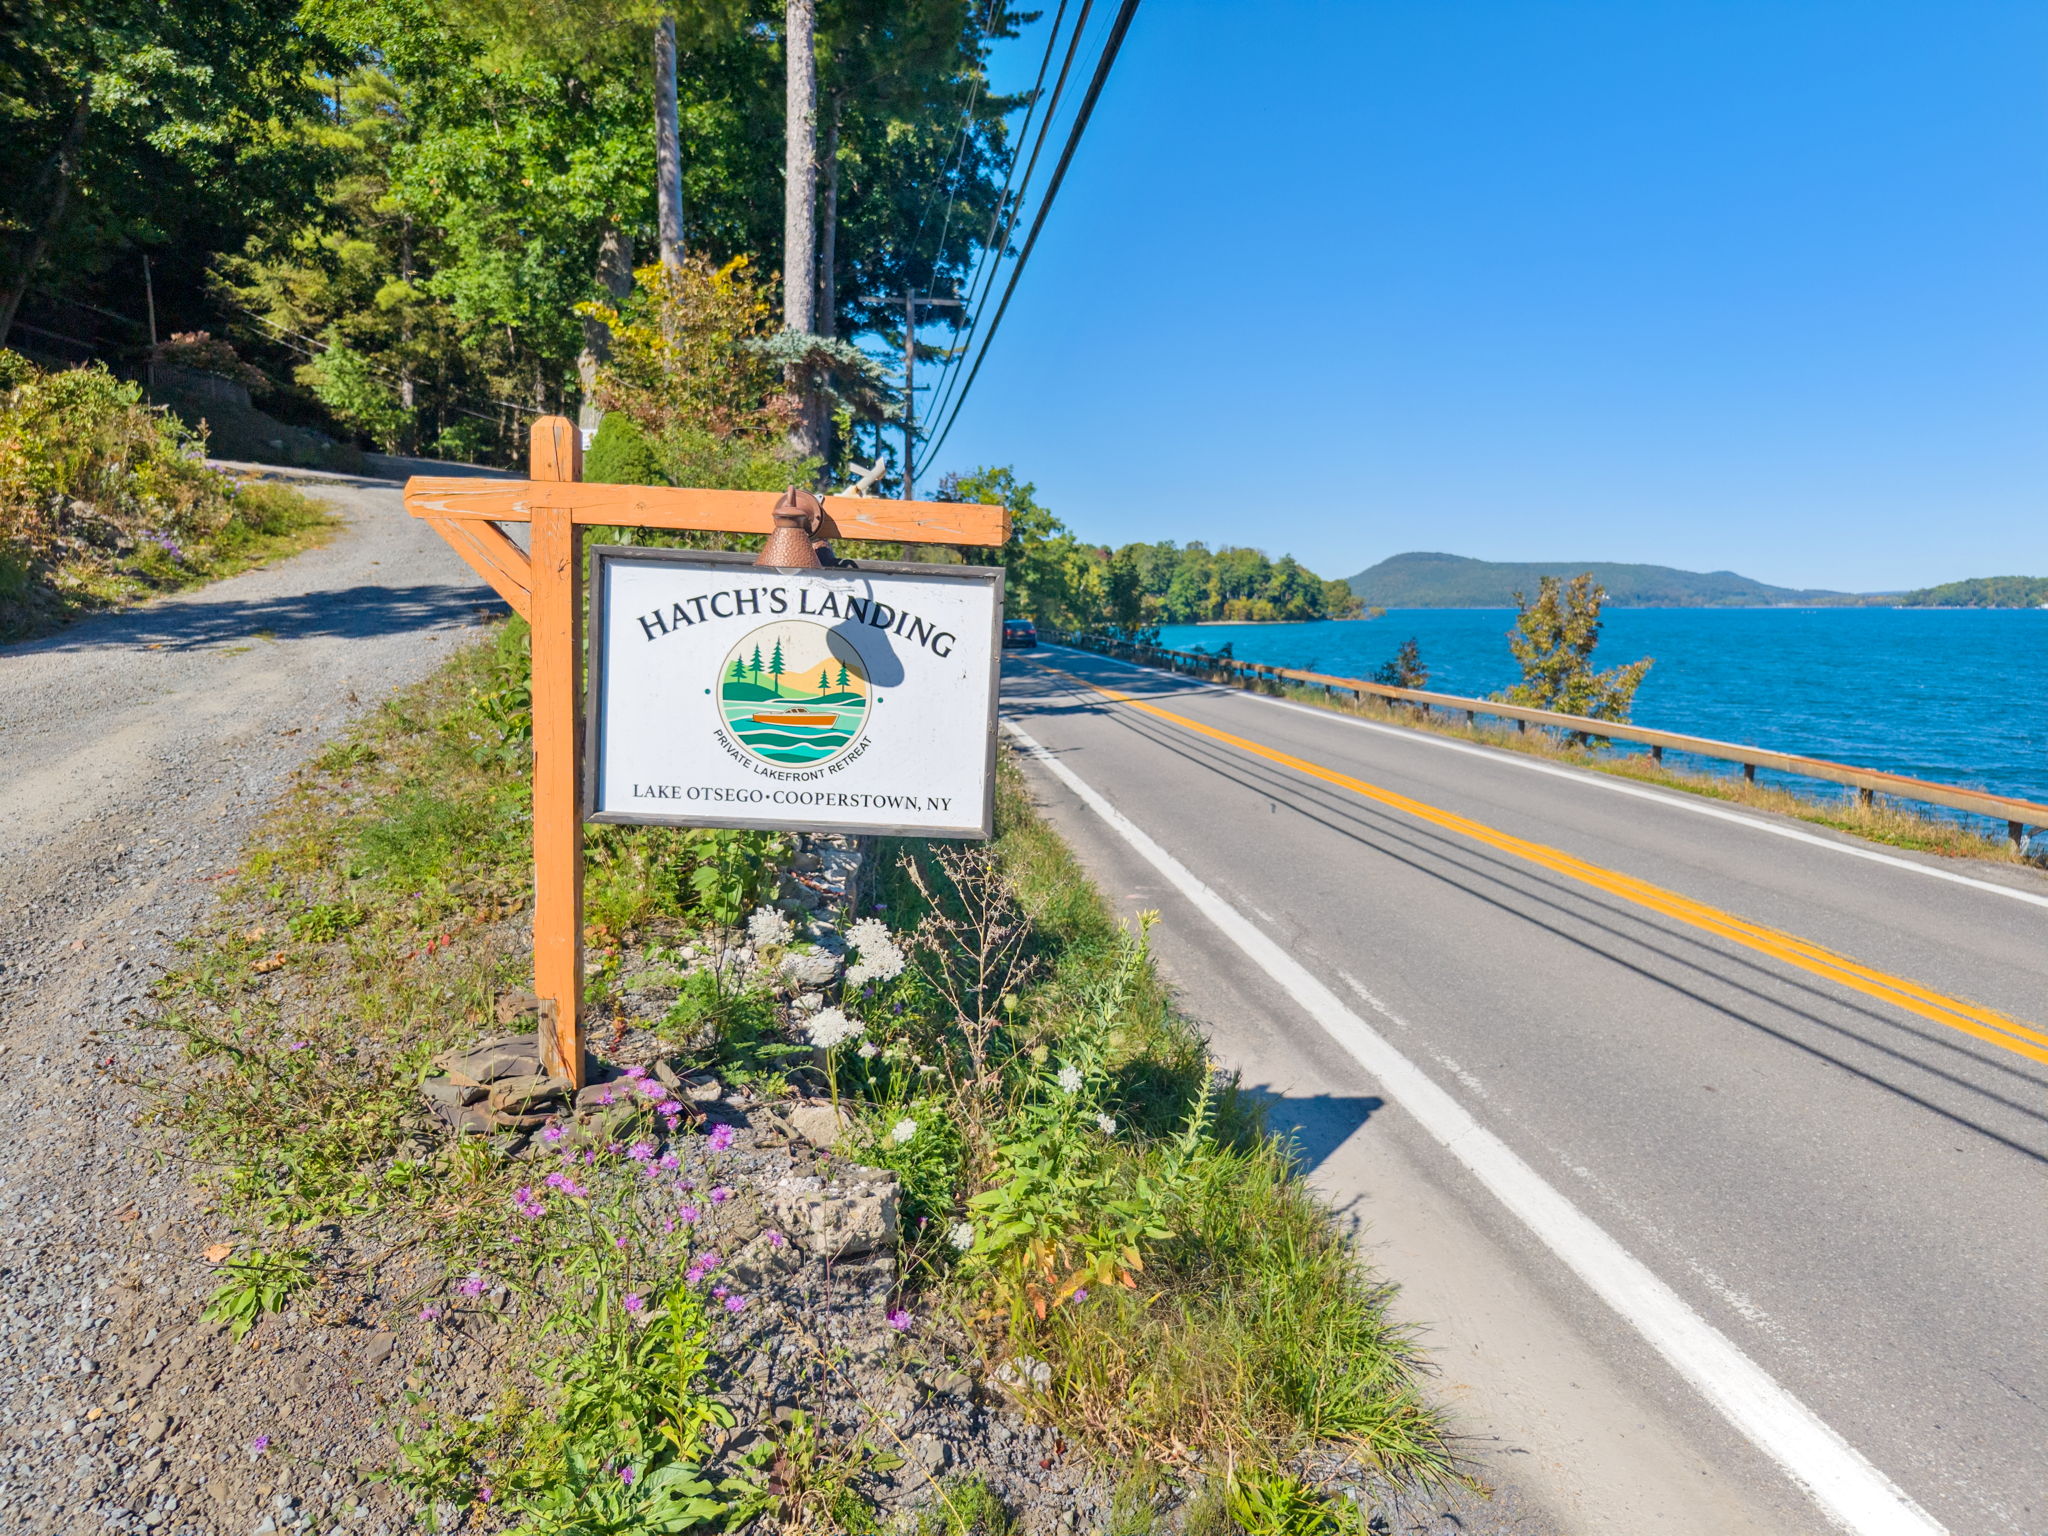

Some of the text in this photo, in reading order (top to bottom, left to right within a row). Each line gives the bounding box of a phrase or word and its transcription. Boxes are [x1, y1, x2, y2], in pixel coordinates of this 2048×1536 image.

[636, 587, 957, 658] HATCH'S LANDING
[713, 728, 872, 782] PRIVATE LAKEFRONT RETREAT
[633, 783, 682, 800] LAKE
[686, 786, 763, 804] OTSEGO
[926, 797, 952, 812] NY
